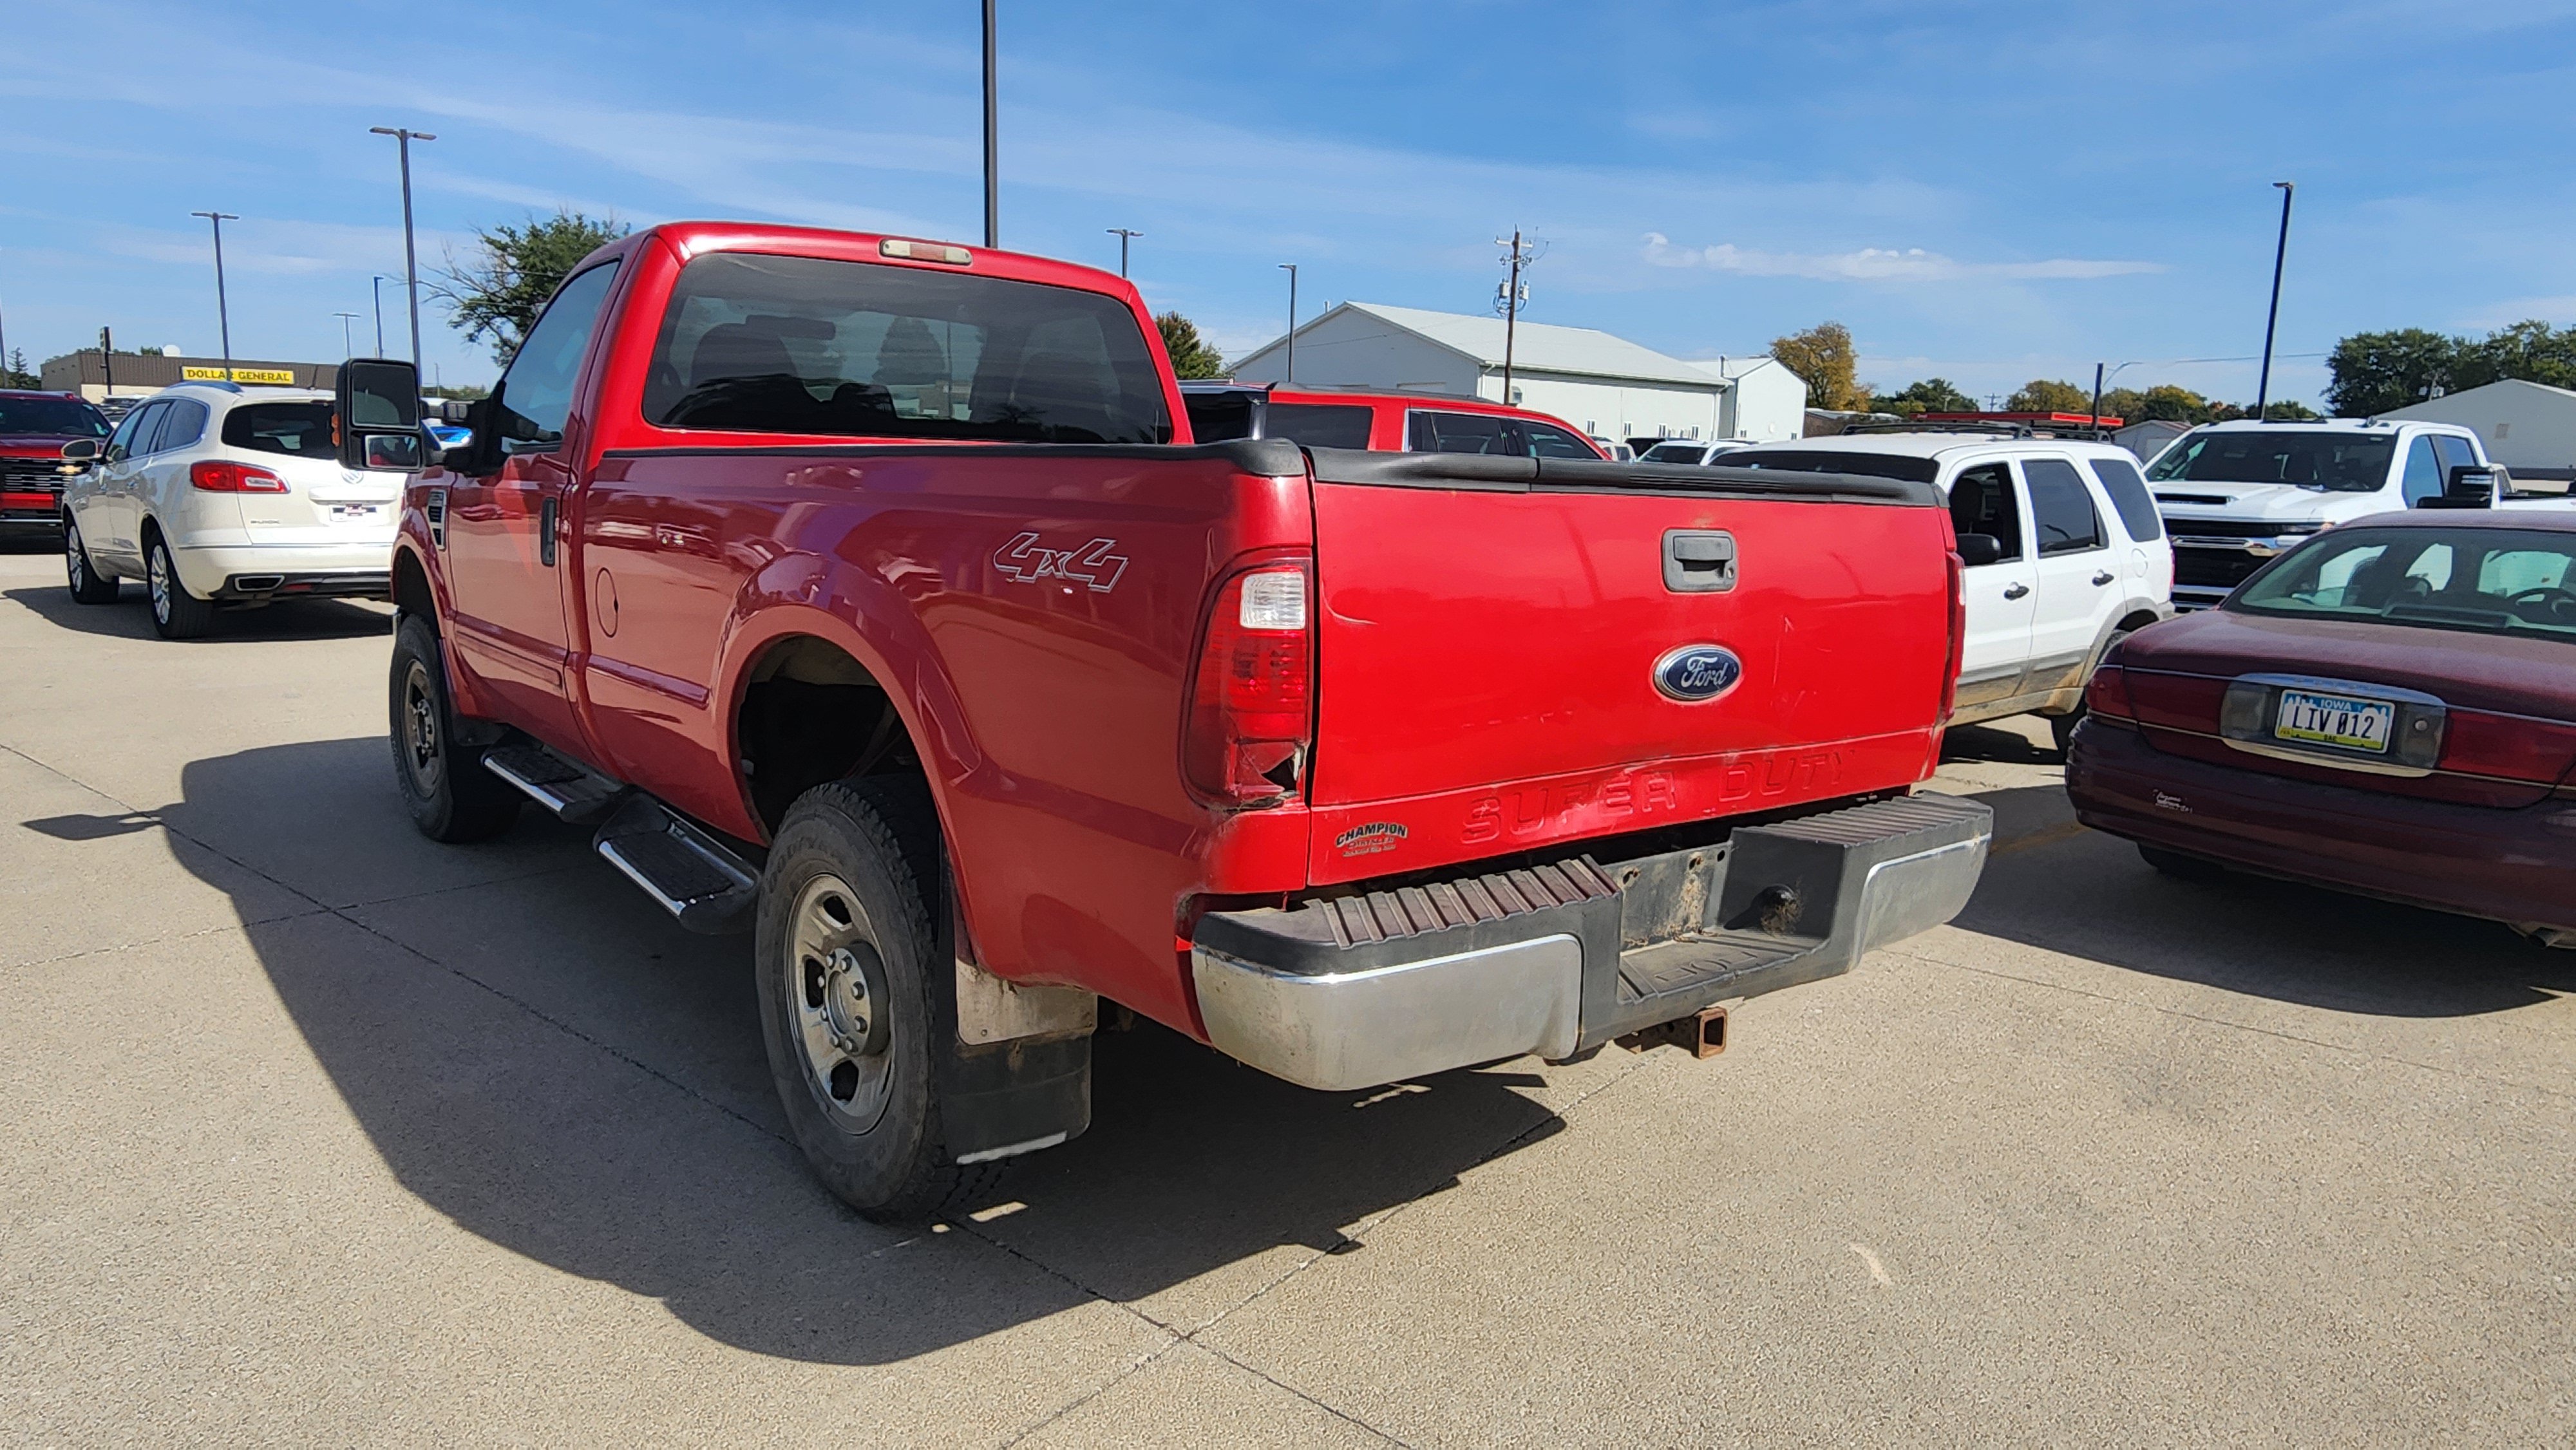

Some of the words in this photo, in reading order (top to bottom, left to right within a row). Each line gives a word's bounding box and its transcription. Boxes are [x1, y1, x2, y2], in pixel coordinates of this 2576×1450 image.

[238, 371, 290, 381] GENERAL
[993, 531, 1130, 594] 4x4
[1681, 656, 1729, 688] Ford
[2320, 699, 2353, 711] IOWA
[2292, 706, 2332, 732] LIV
[2336, 712, 2374, 739] 012
[1461, 771, 1676, 844] SUPER
[1719, 749, 1855, 802] DUTY
[1336, 822, 1408, 847] CHAMPION
